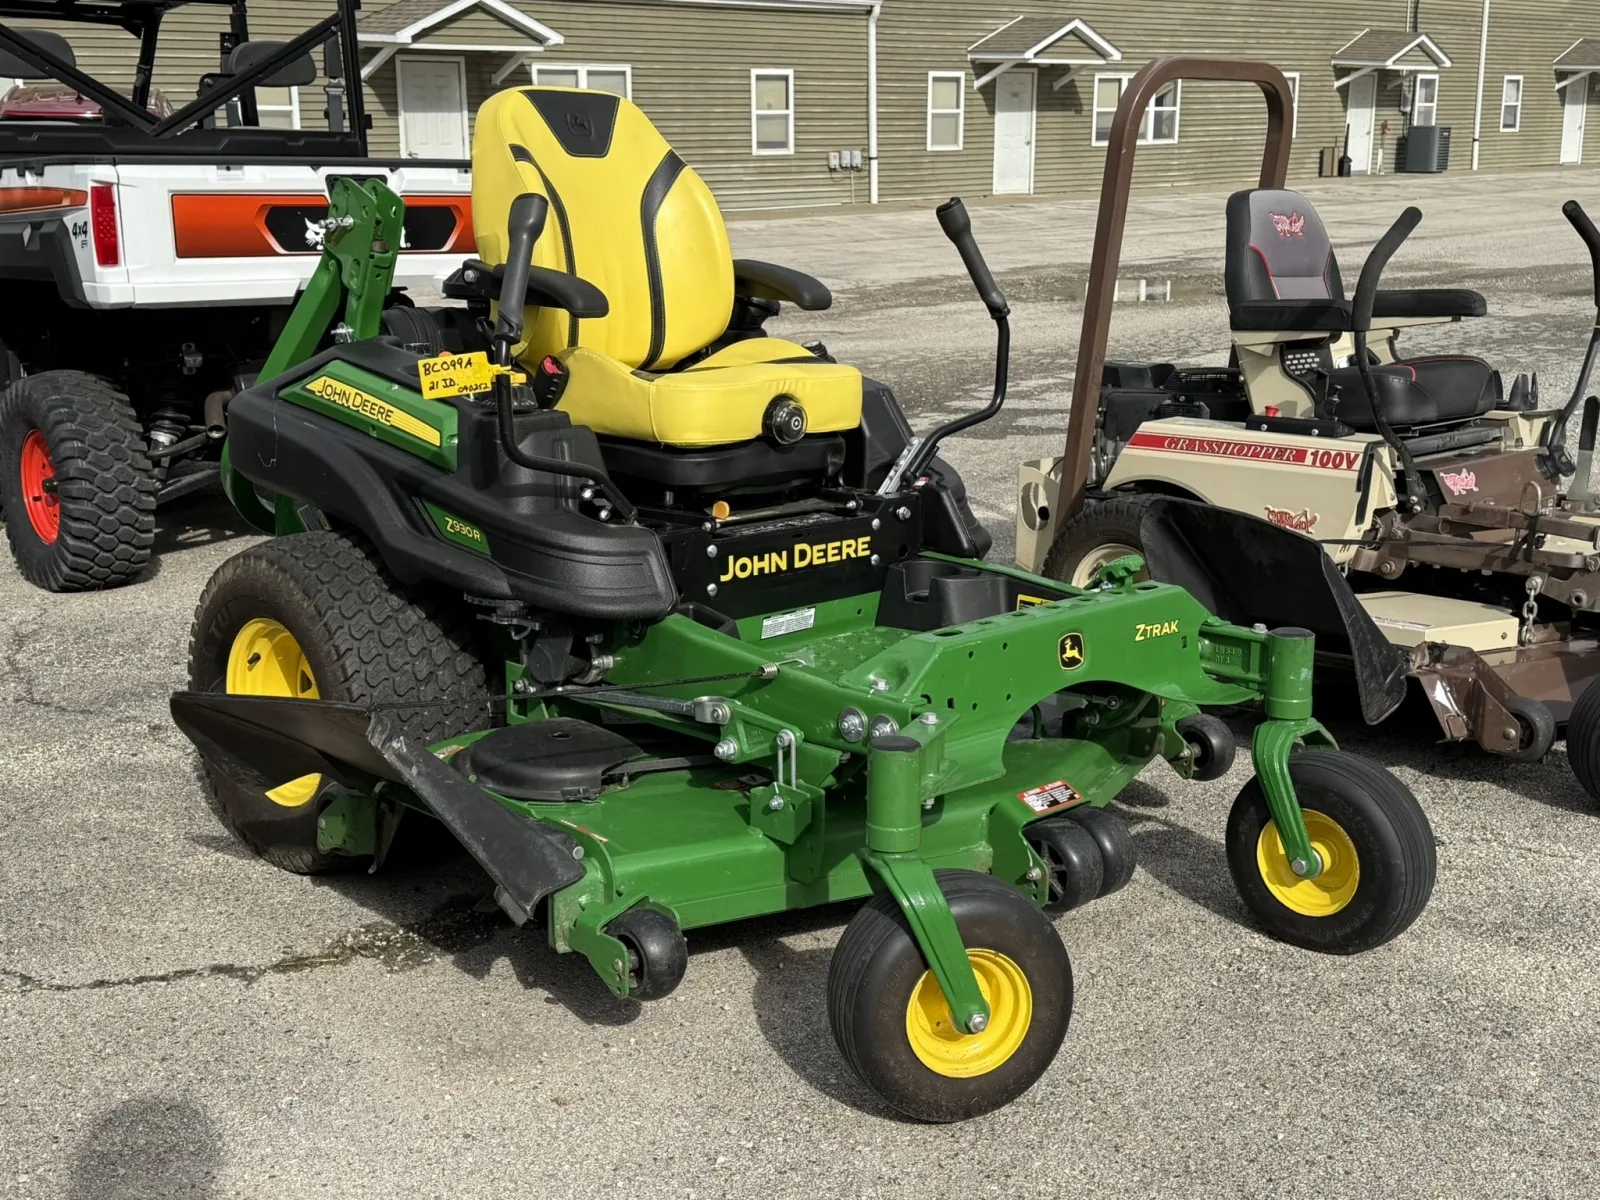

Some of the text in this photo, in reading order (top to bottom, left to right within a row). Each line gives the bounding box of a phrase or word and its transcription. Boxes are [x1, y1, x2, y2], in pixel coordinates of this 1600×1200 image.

[72, 221, 88, 239] 4x4
[317, 381, 395, 423] JOHN DEERE
[1164, 437, 1360, 470] GRASSHOPPER 100V
[720, 536, 871, 582] JOHN DEERE
[1135, 619, 1179, 641] ZTRAK
